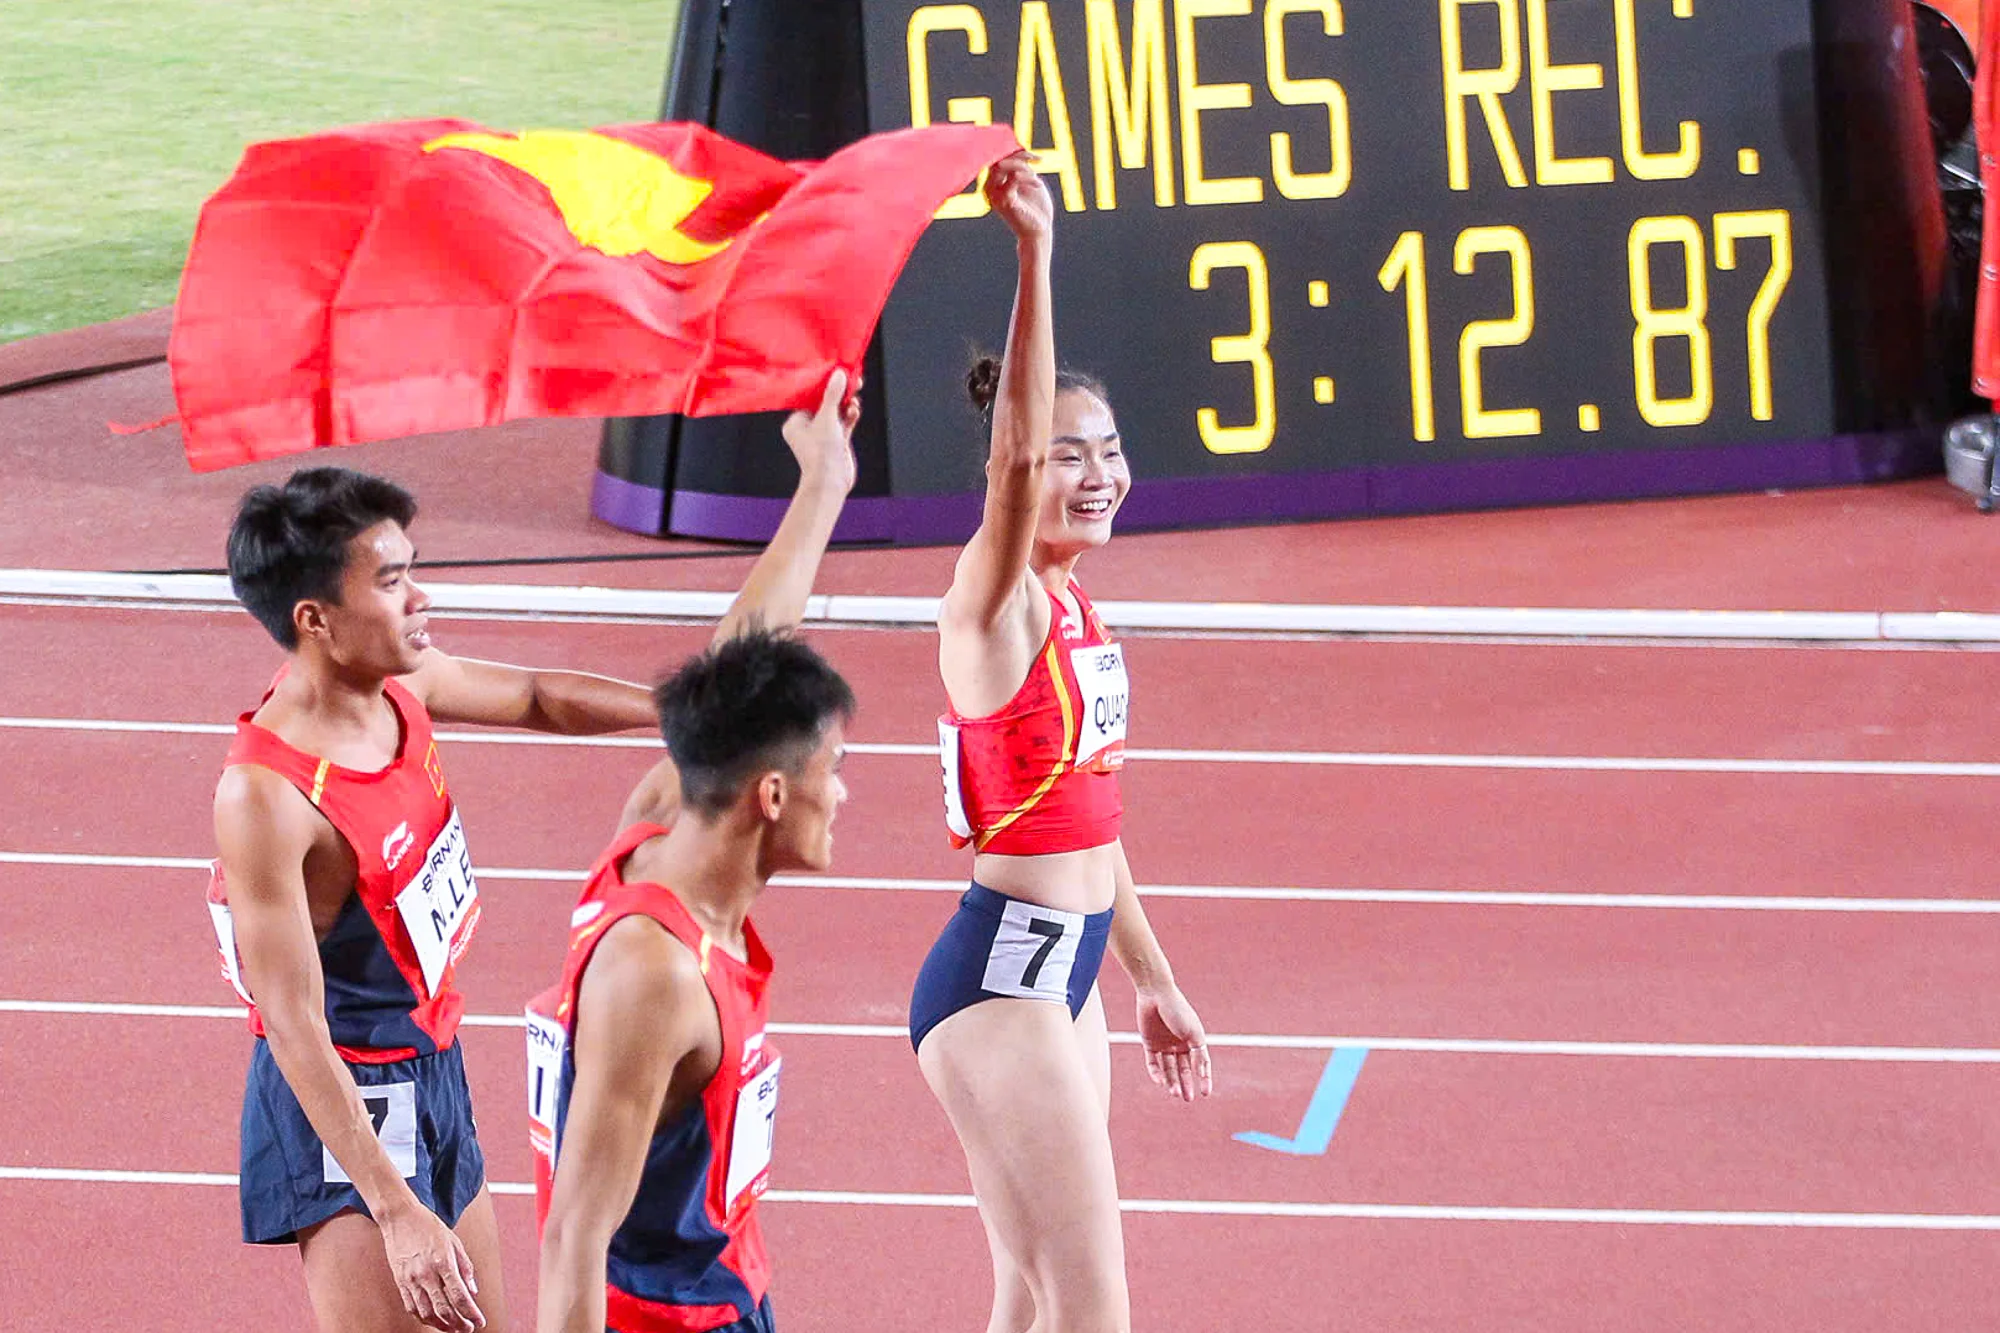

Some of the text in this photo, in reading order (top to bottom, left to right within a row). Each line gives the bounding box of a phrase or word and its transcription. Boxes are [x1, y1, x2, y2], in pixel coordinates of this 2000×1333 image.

[906, 0, 1760, 221] GAMES REC.
[1188, 209, 1793, 455] 3:12.87
[1020, 917, 1065, 989] 7
[362, 1096, 389, 1138] 7
